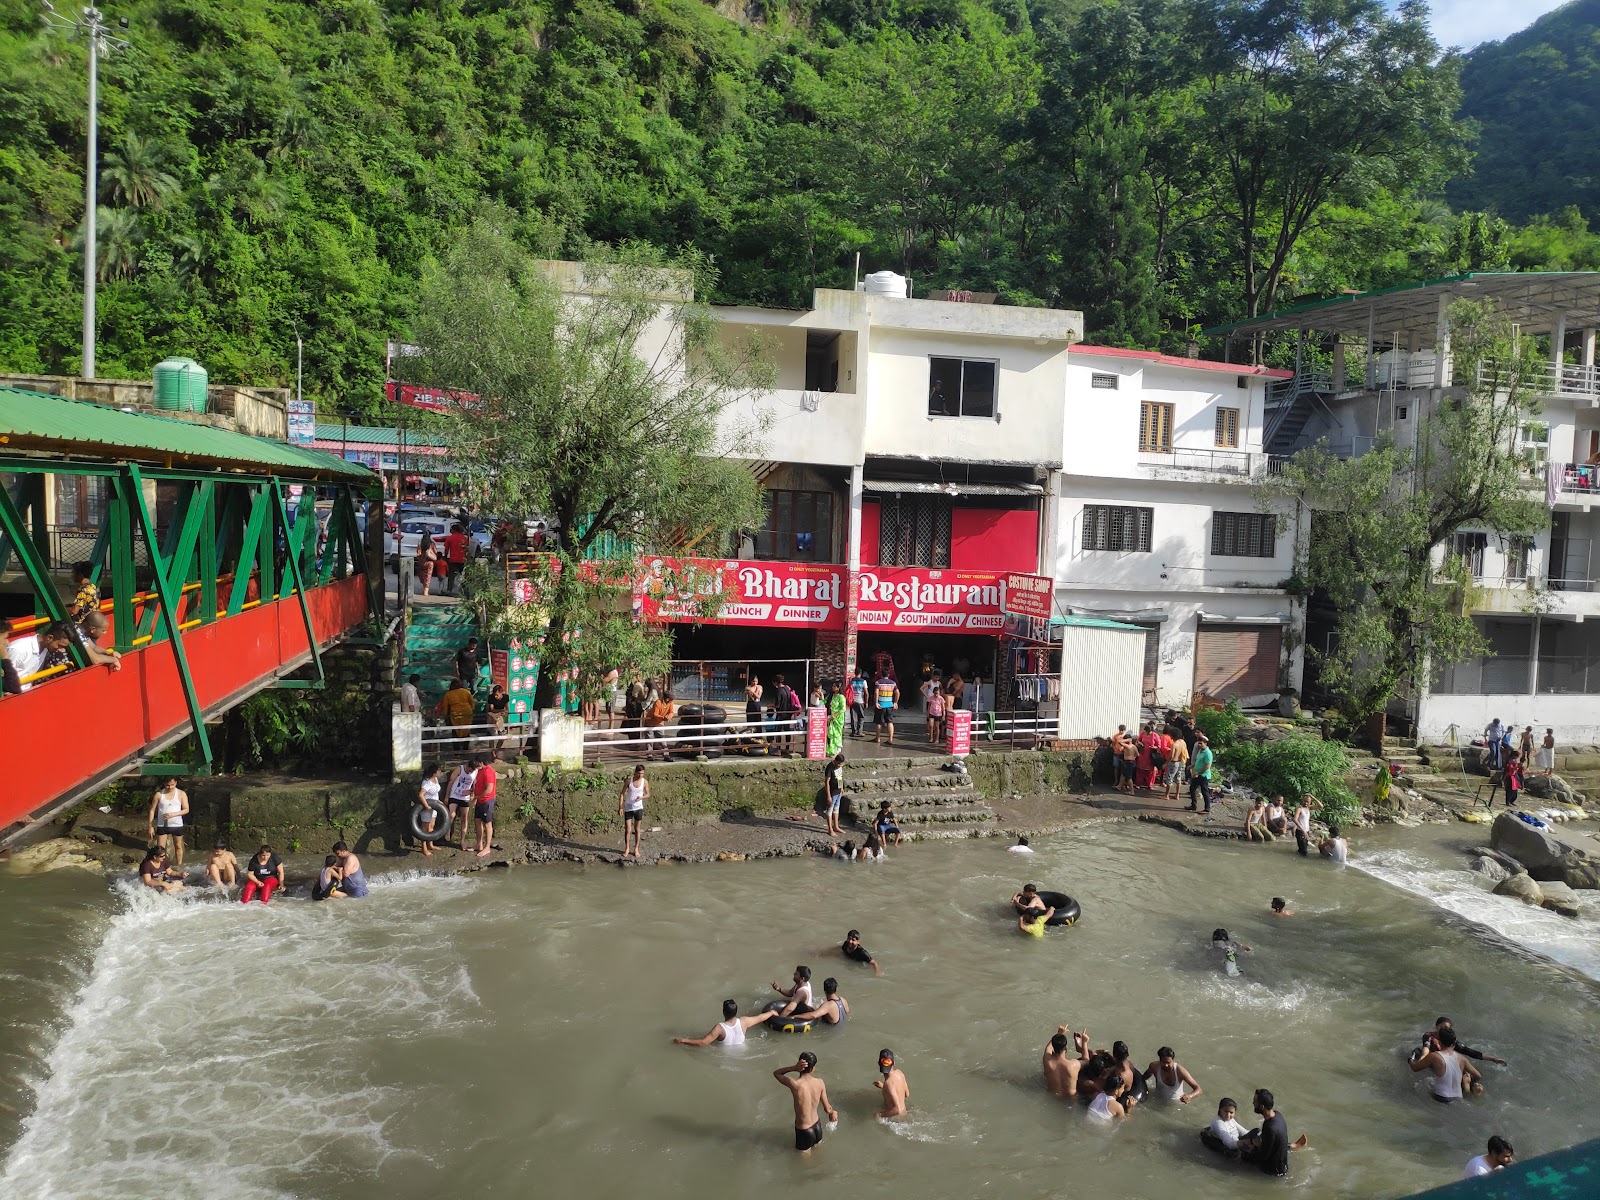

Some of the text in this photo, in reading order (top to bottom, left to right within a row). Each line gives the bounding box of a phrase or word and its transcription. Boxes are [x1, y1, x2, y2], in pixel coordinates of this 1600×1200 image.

[739, 567, 845, 609] Bharat
[1008, 575, 1050, 593] COSTUME SHOP
[859, 572, 1008, 614] Restaurant
[727, 606, 762, 616] LUNCH
[783, 609, 821, 619] DINNER
[859, 611, 889, 623] INDIAN
[901, 614, 960, 625] SOUTH INDIAN
[971, 616, 1002, 627] CHINESE
